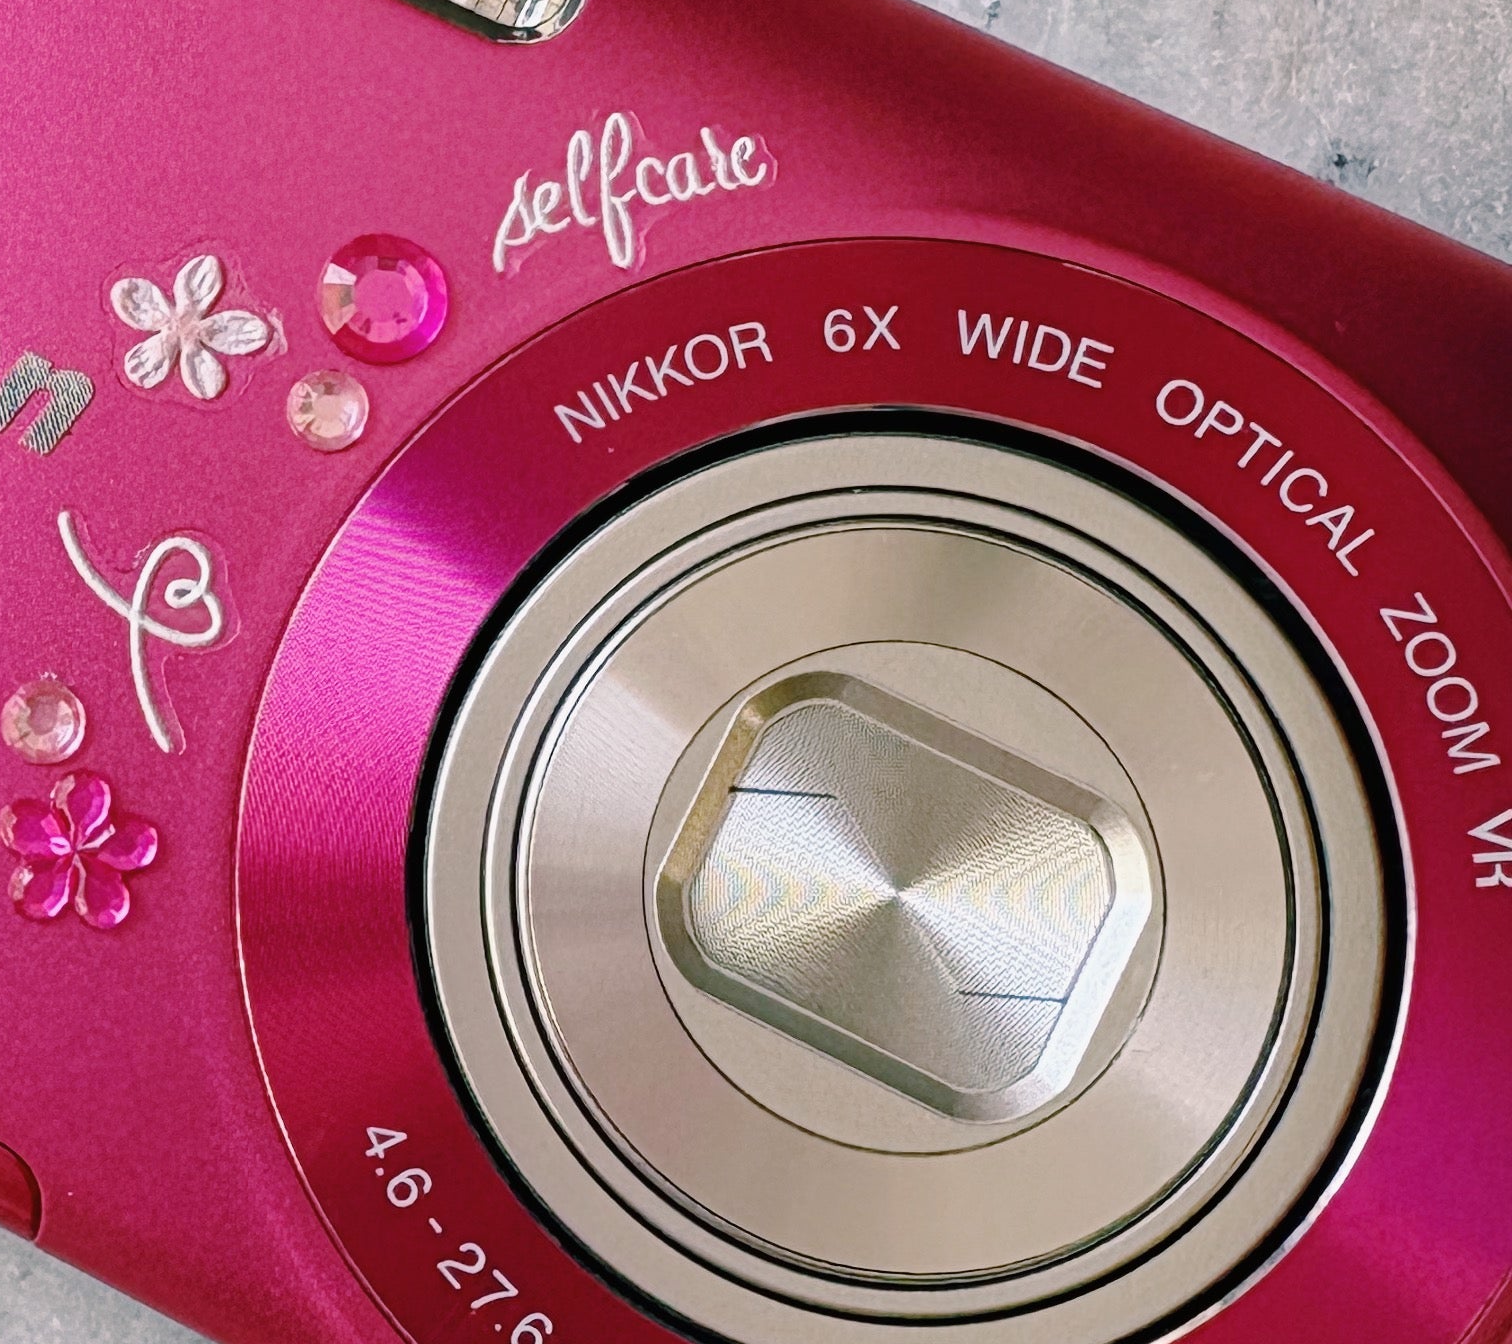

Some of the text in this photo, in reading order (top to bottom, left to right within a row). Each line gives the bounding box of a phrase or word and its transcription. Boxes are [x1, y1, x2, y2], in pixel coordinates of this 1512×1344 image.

[492, 112, 769, 273] selfcare
[553, 305, 1512, 888] NIKKOR 6X WIDE OPTICAL ZOOM VR
